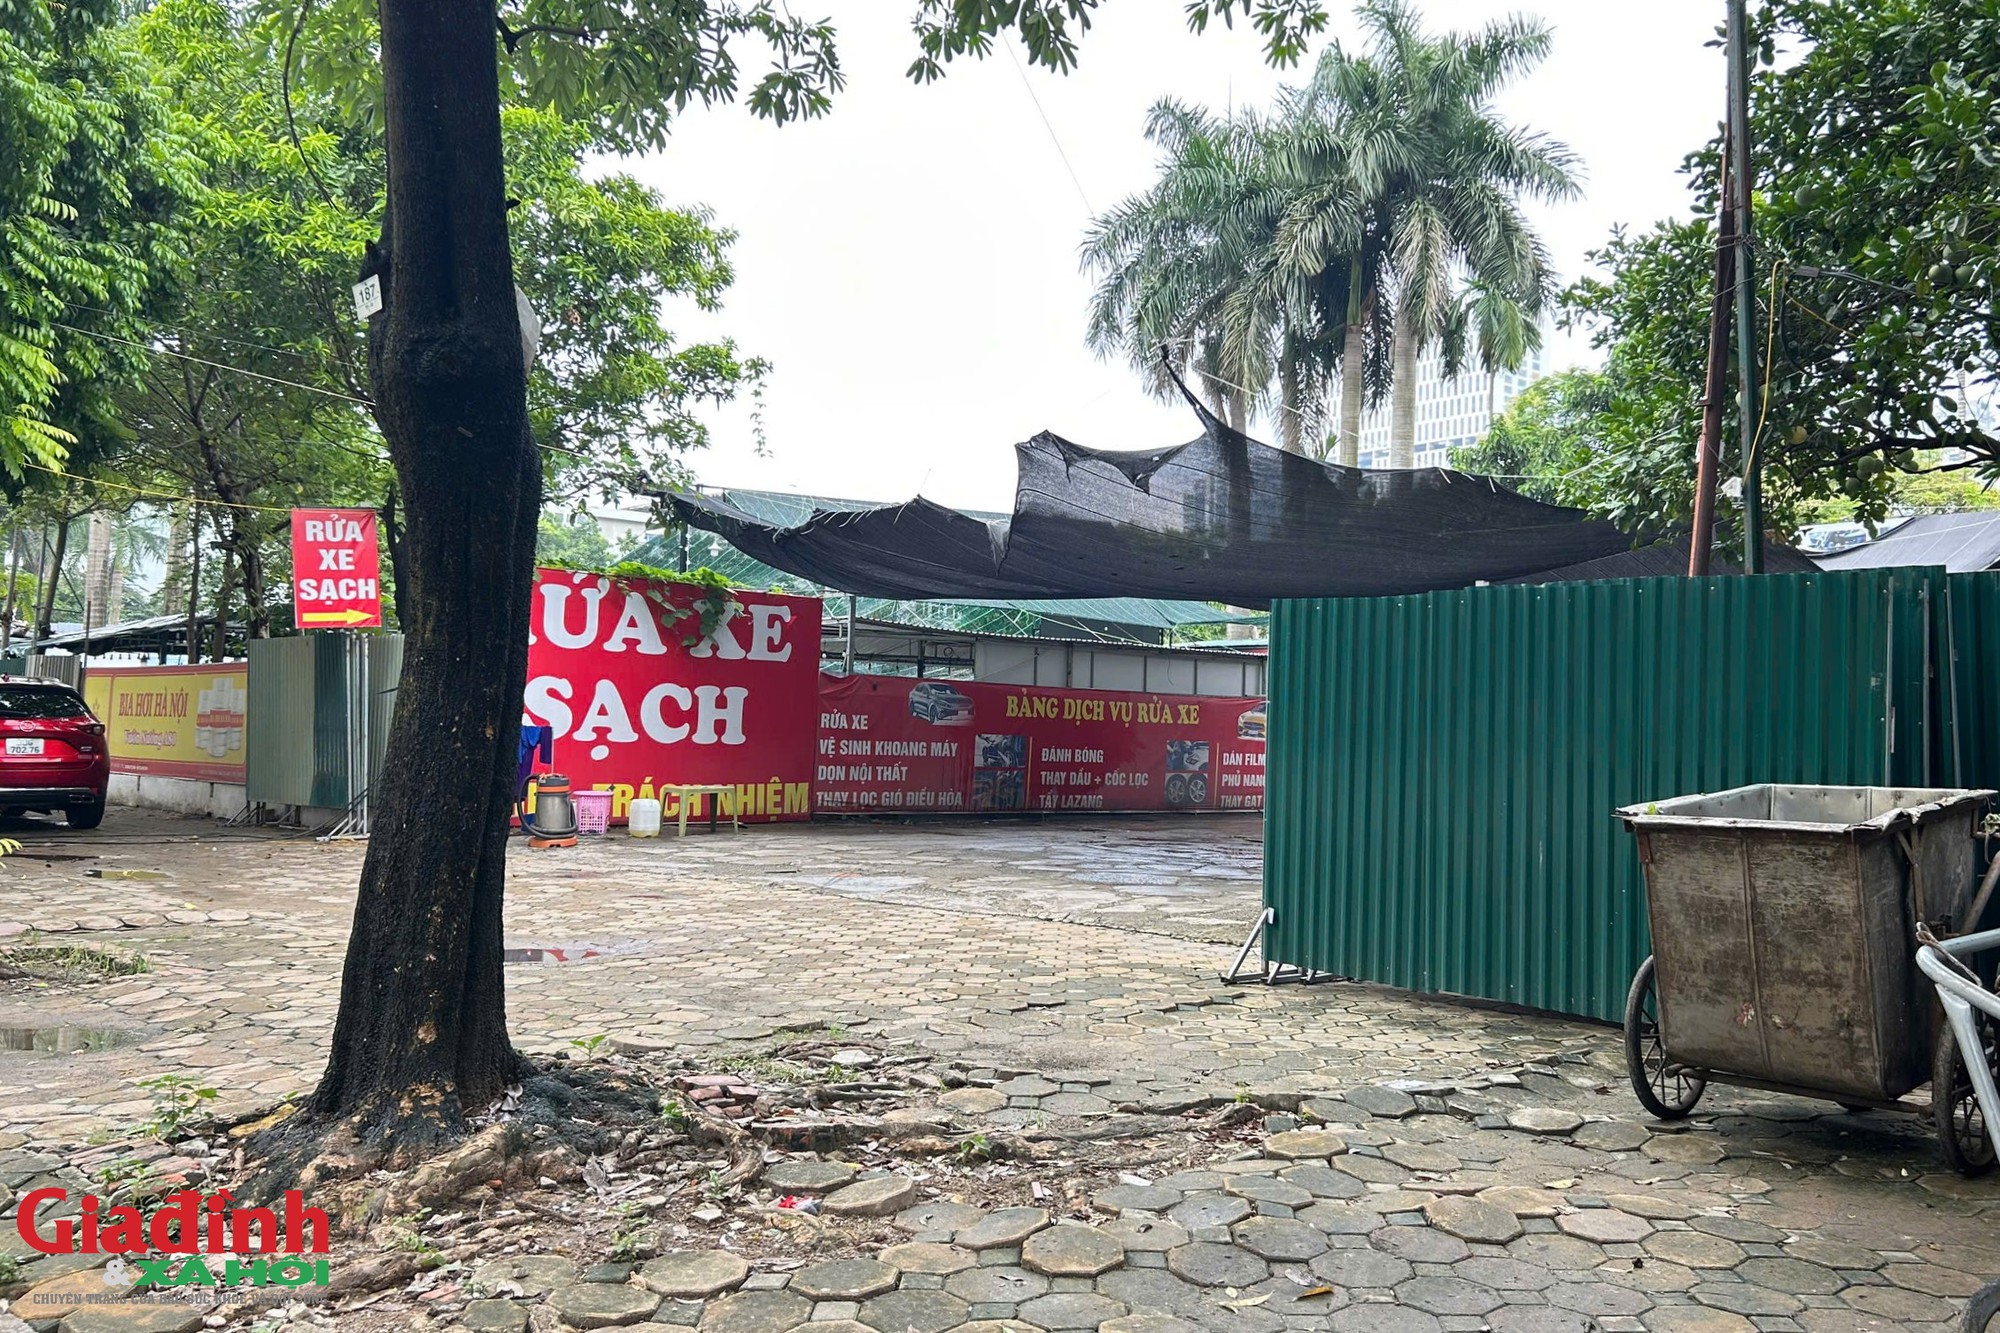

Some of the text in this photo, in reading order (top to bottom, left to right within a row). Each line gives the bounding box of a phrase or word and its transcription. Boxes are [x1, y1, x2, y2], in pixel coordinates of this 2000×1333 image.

[359, 284, 375, 303] 187
[305, 513, 364, 542] RỬA
[318, 549, 355, 570] XE
[299, 578, 377, 605] SẠCH
[689, 599, 792, 663] XE
[118, 692, 134, 716] BIA
[135, 692, 153, 717] HƠI
[154, 686, 168, 717] HÀ
[169, 687, 190, 724] NỘI
[1006, 687, 1200, 728] BẢNG DỊCH VỤ RỬA XE
[522, 675, 749, 760] SẠCH
[820, 708, 869, 730] RỬA XE
[819, 736, 958, 758] VỆ SINH KHOANG MÁY
[1041, 745, 1104, 763] ĐÁNH BÓNG
[1222, 750, 1243, 766] DÁN
[818, 761, 908, 784] DỌN NỘI THẤT
[1040, 771, 1067, 786] THAY
[1094, 776, 1101, 784] +
[1129, 772, 1149, 789] LỌC
[1222, 770, 1240, 787] PHỦ
[816, 791, 849, 807] THAY
[881, 788, 902, 806] GIÓ
[1061, 794, 1103, 809] LAZANG
[1220, 795, 1262, 809] THAY GẠT
